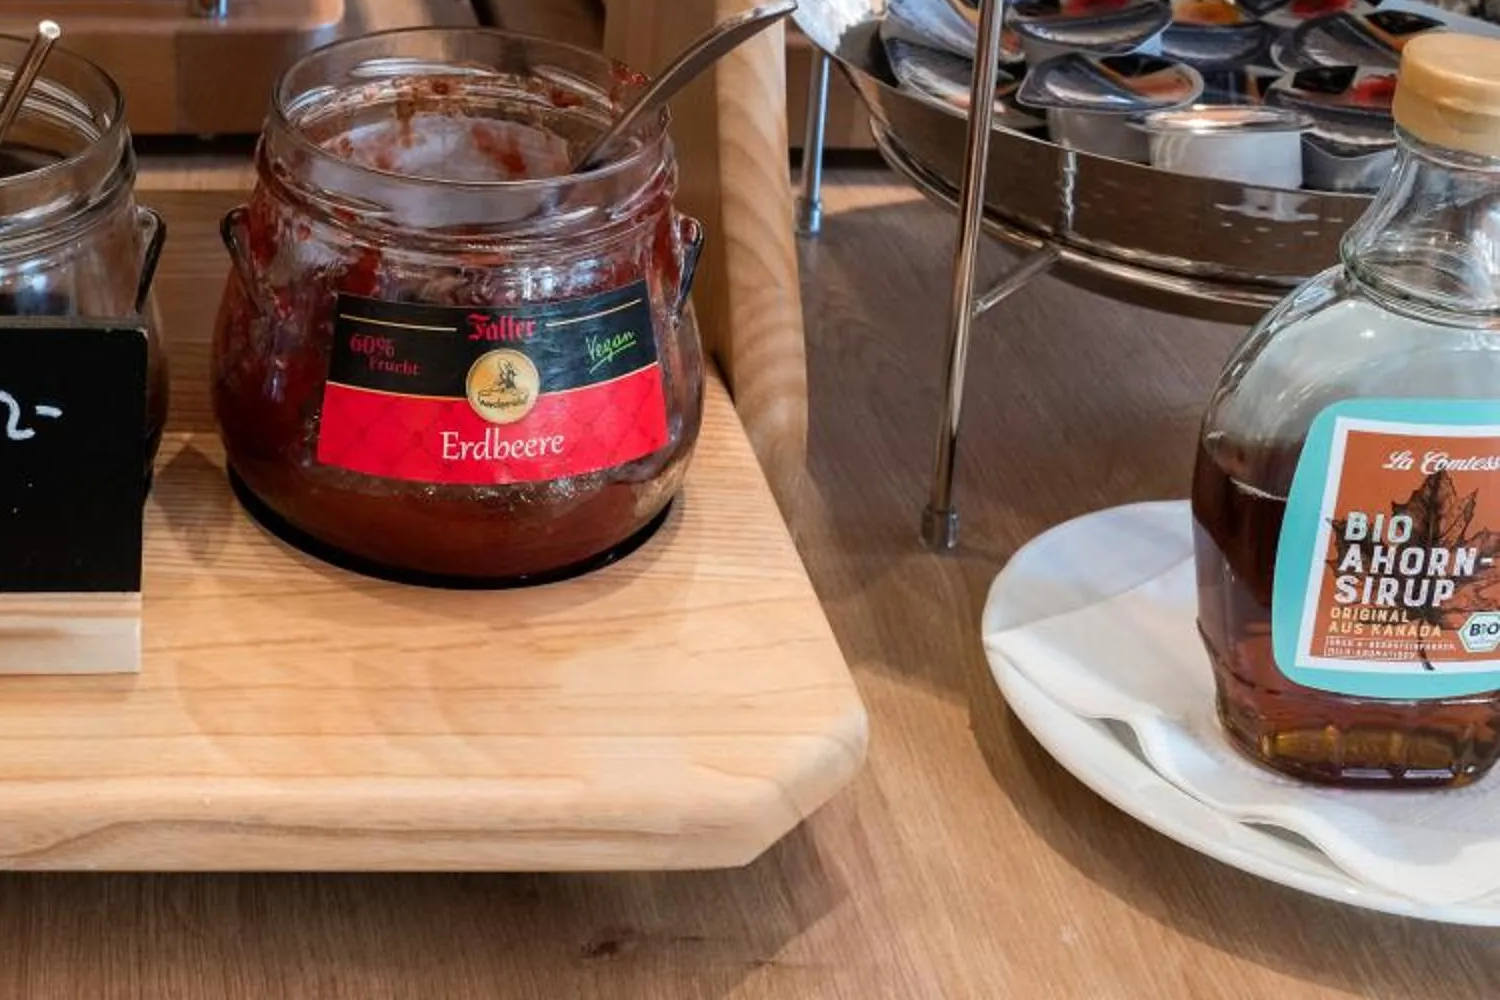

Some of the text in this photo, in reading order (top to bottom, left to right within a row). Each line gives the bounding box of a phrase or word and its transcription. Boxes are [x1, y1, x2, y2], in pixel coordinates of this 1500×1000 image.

[467, 312, 537, 342] Faller
[349, 333, 396, 358] 60%
[585, 328, 634, 364] Vegan
[440, 427, 565, 461] Erdbeere
[1344, 511, 1413, 544] BIO
[1337, 544, 1493, 577] AHORN-
[1334, 575, 1455, 608] SIRUP
[1328, 621, 1442, 637] AUS KANADA
[1331, 606, 1410, 623] ORIGINAL
